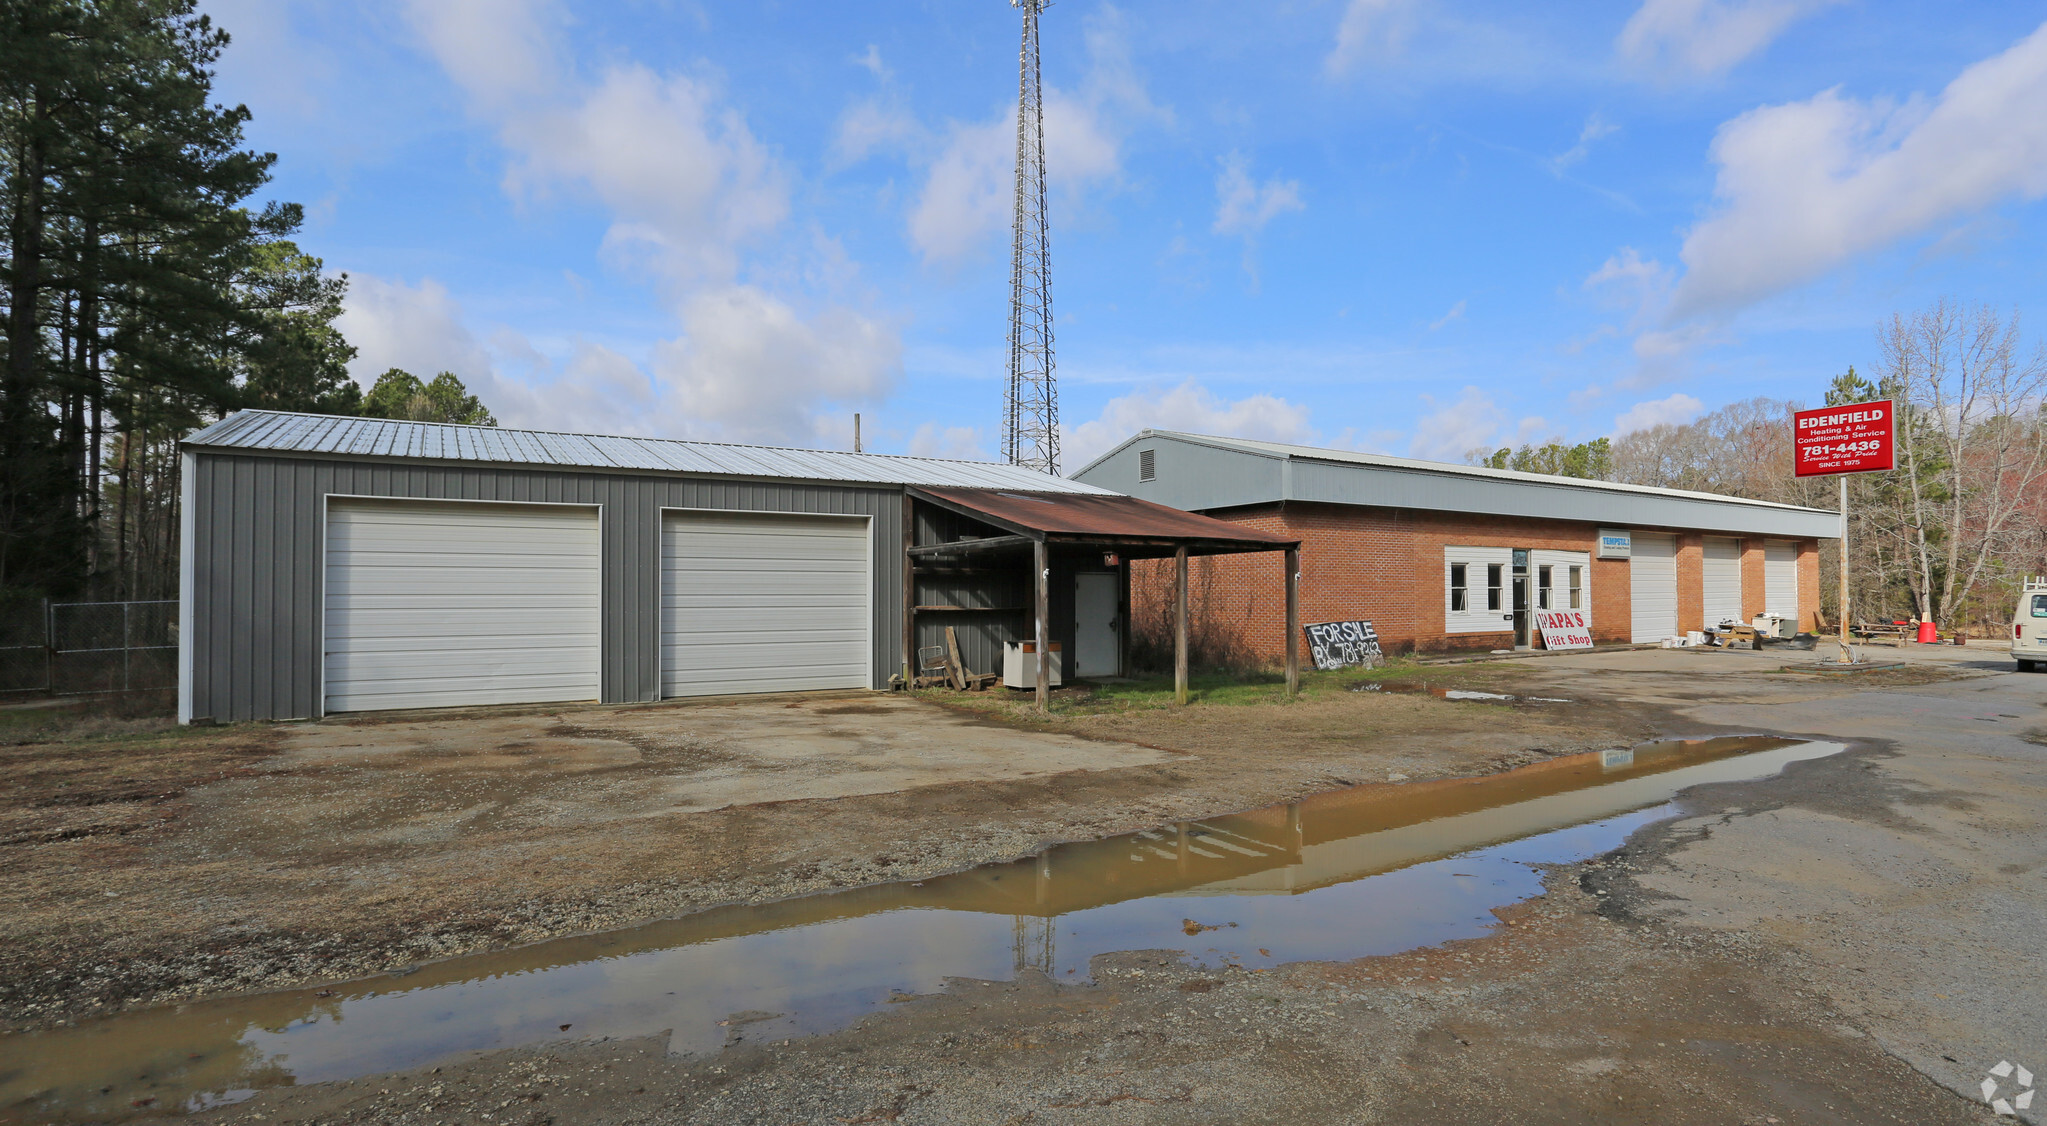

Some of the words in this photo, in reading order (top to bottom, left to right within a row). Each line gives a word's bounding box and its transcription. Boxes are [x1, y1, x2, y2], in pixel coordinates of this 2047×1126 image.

[1799, 409, 1884, 429] EDENFIELD
[1797, 434, 1849, 444] Conditioning
[1852, 430, 1886, 439] Service
[1810, 426, 1842, 436] Heating
[1802, 440, 1881, 456] 781-4436
[1803, 455, 1830, 463] Service
[1854, 450, 1878, 458] Pride
[1843, 459, 1861, 467] 1975
[1538, 612, 1584, 629] PAPA'S
[1310, 623, 1344, 645] FOR
[1342, 621, 1378, 642] SALE
[1546, 635, 1566, 646] Gift
[1567, 634, 1591, 646] Shop
